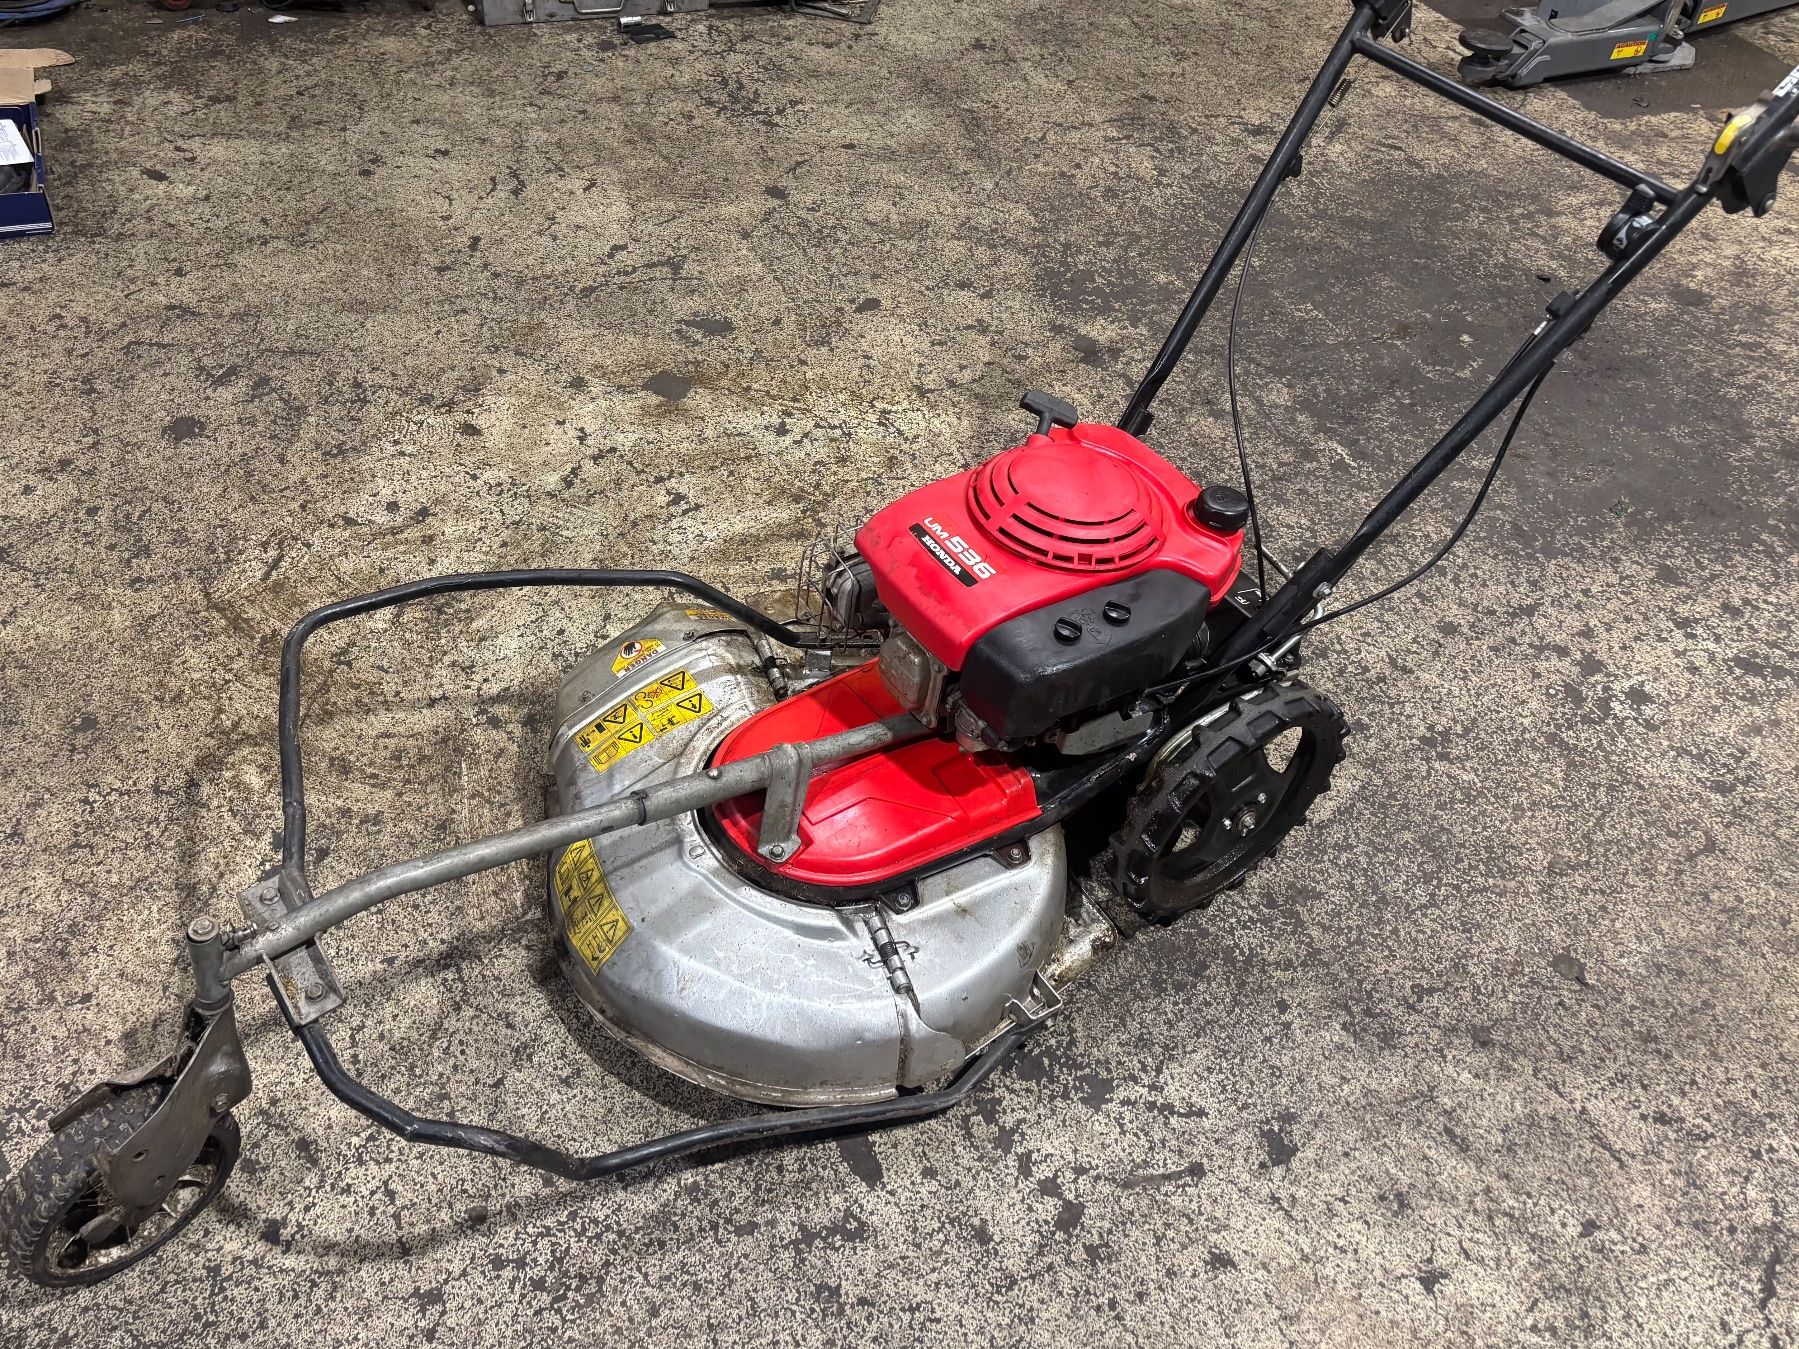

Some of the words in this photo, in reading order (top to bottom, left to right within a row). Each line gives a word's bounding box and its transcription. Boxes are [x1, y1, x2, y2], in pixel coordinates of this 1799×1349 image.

[921, 535, 962, 575] HONDA
[923, 516, 950, 540] UM
[943, 535, 998, 579] 536
[624, 649, 659, 673] DANGER
